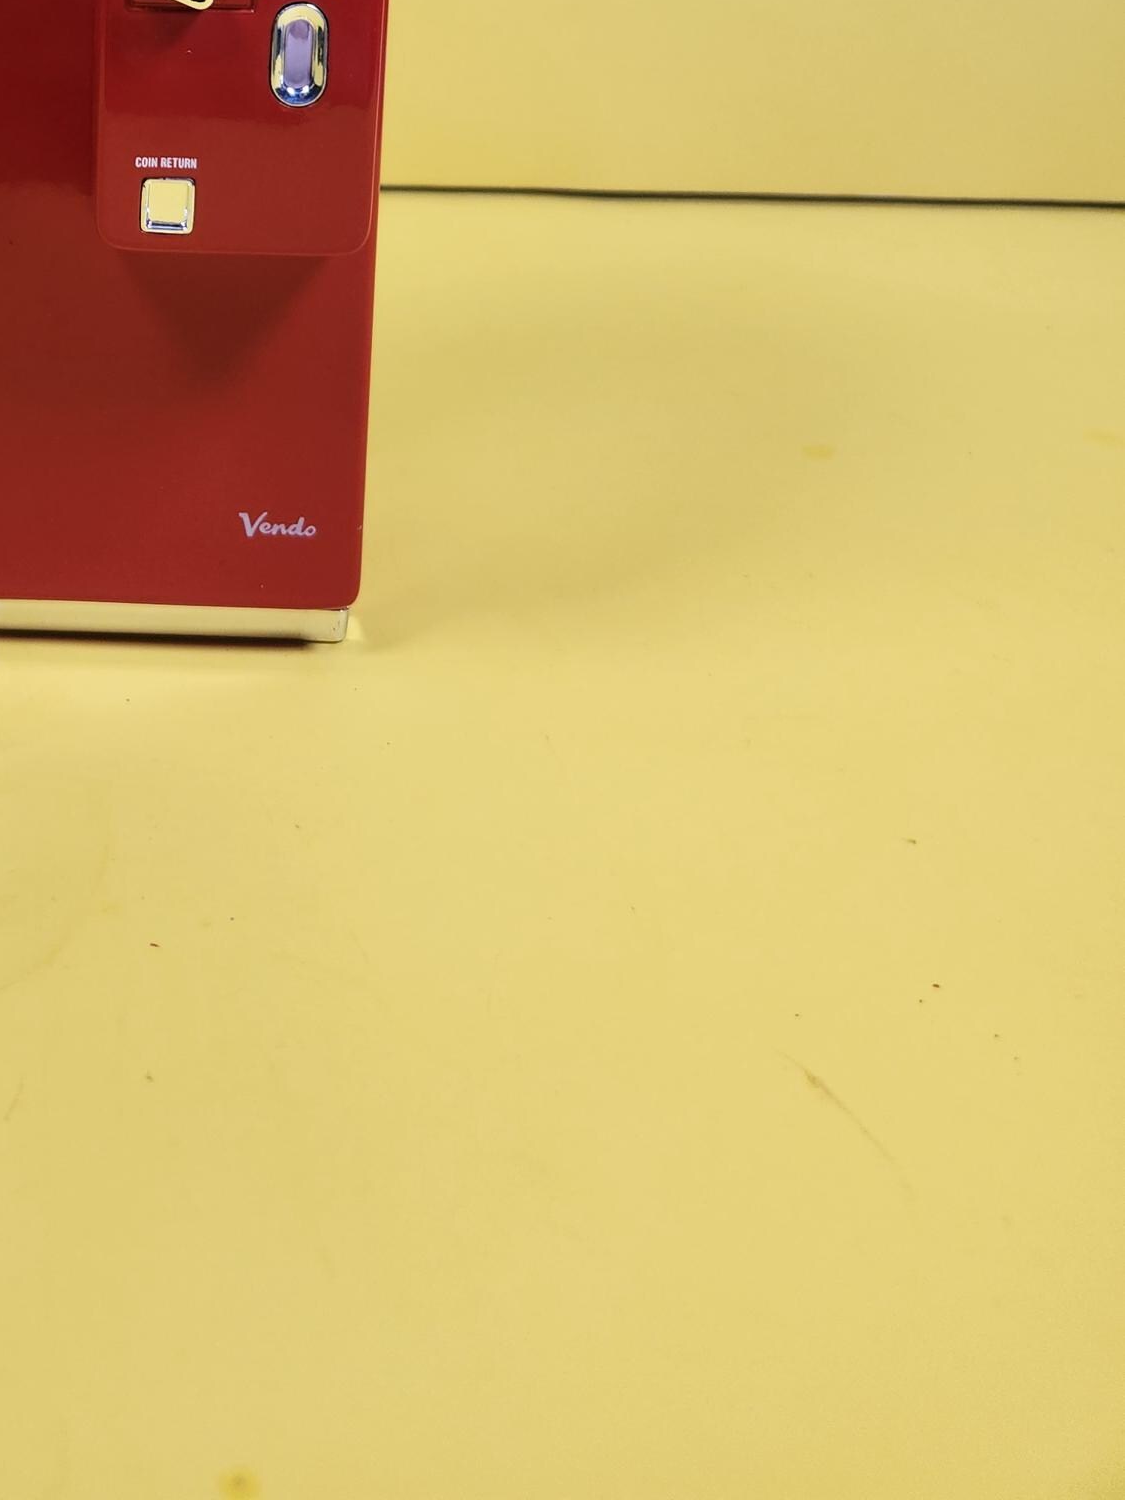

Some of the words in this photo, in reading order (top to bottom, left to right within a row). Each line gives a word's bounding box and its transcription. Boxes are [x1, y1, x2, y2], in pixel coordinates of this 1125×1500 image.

[135, 157, 158, 168] COIN
[160, 157, 197, 169] RETURN
[238, 511, 316, 537] Vendo
